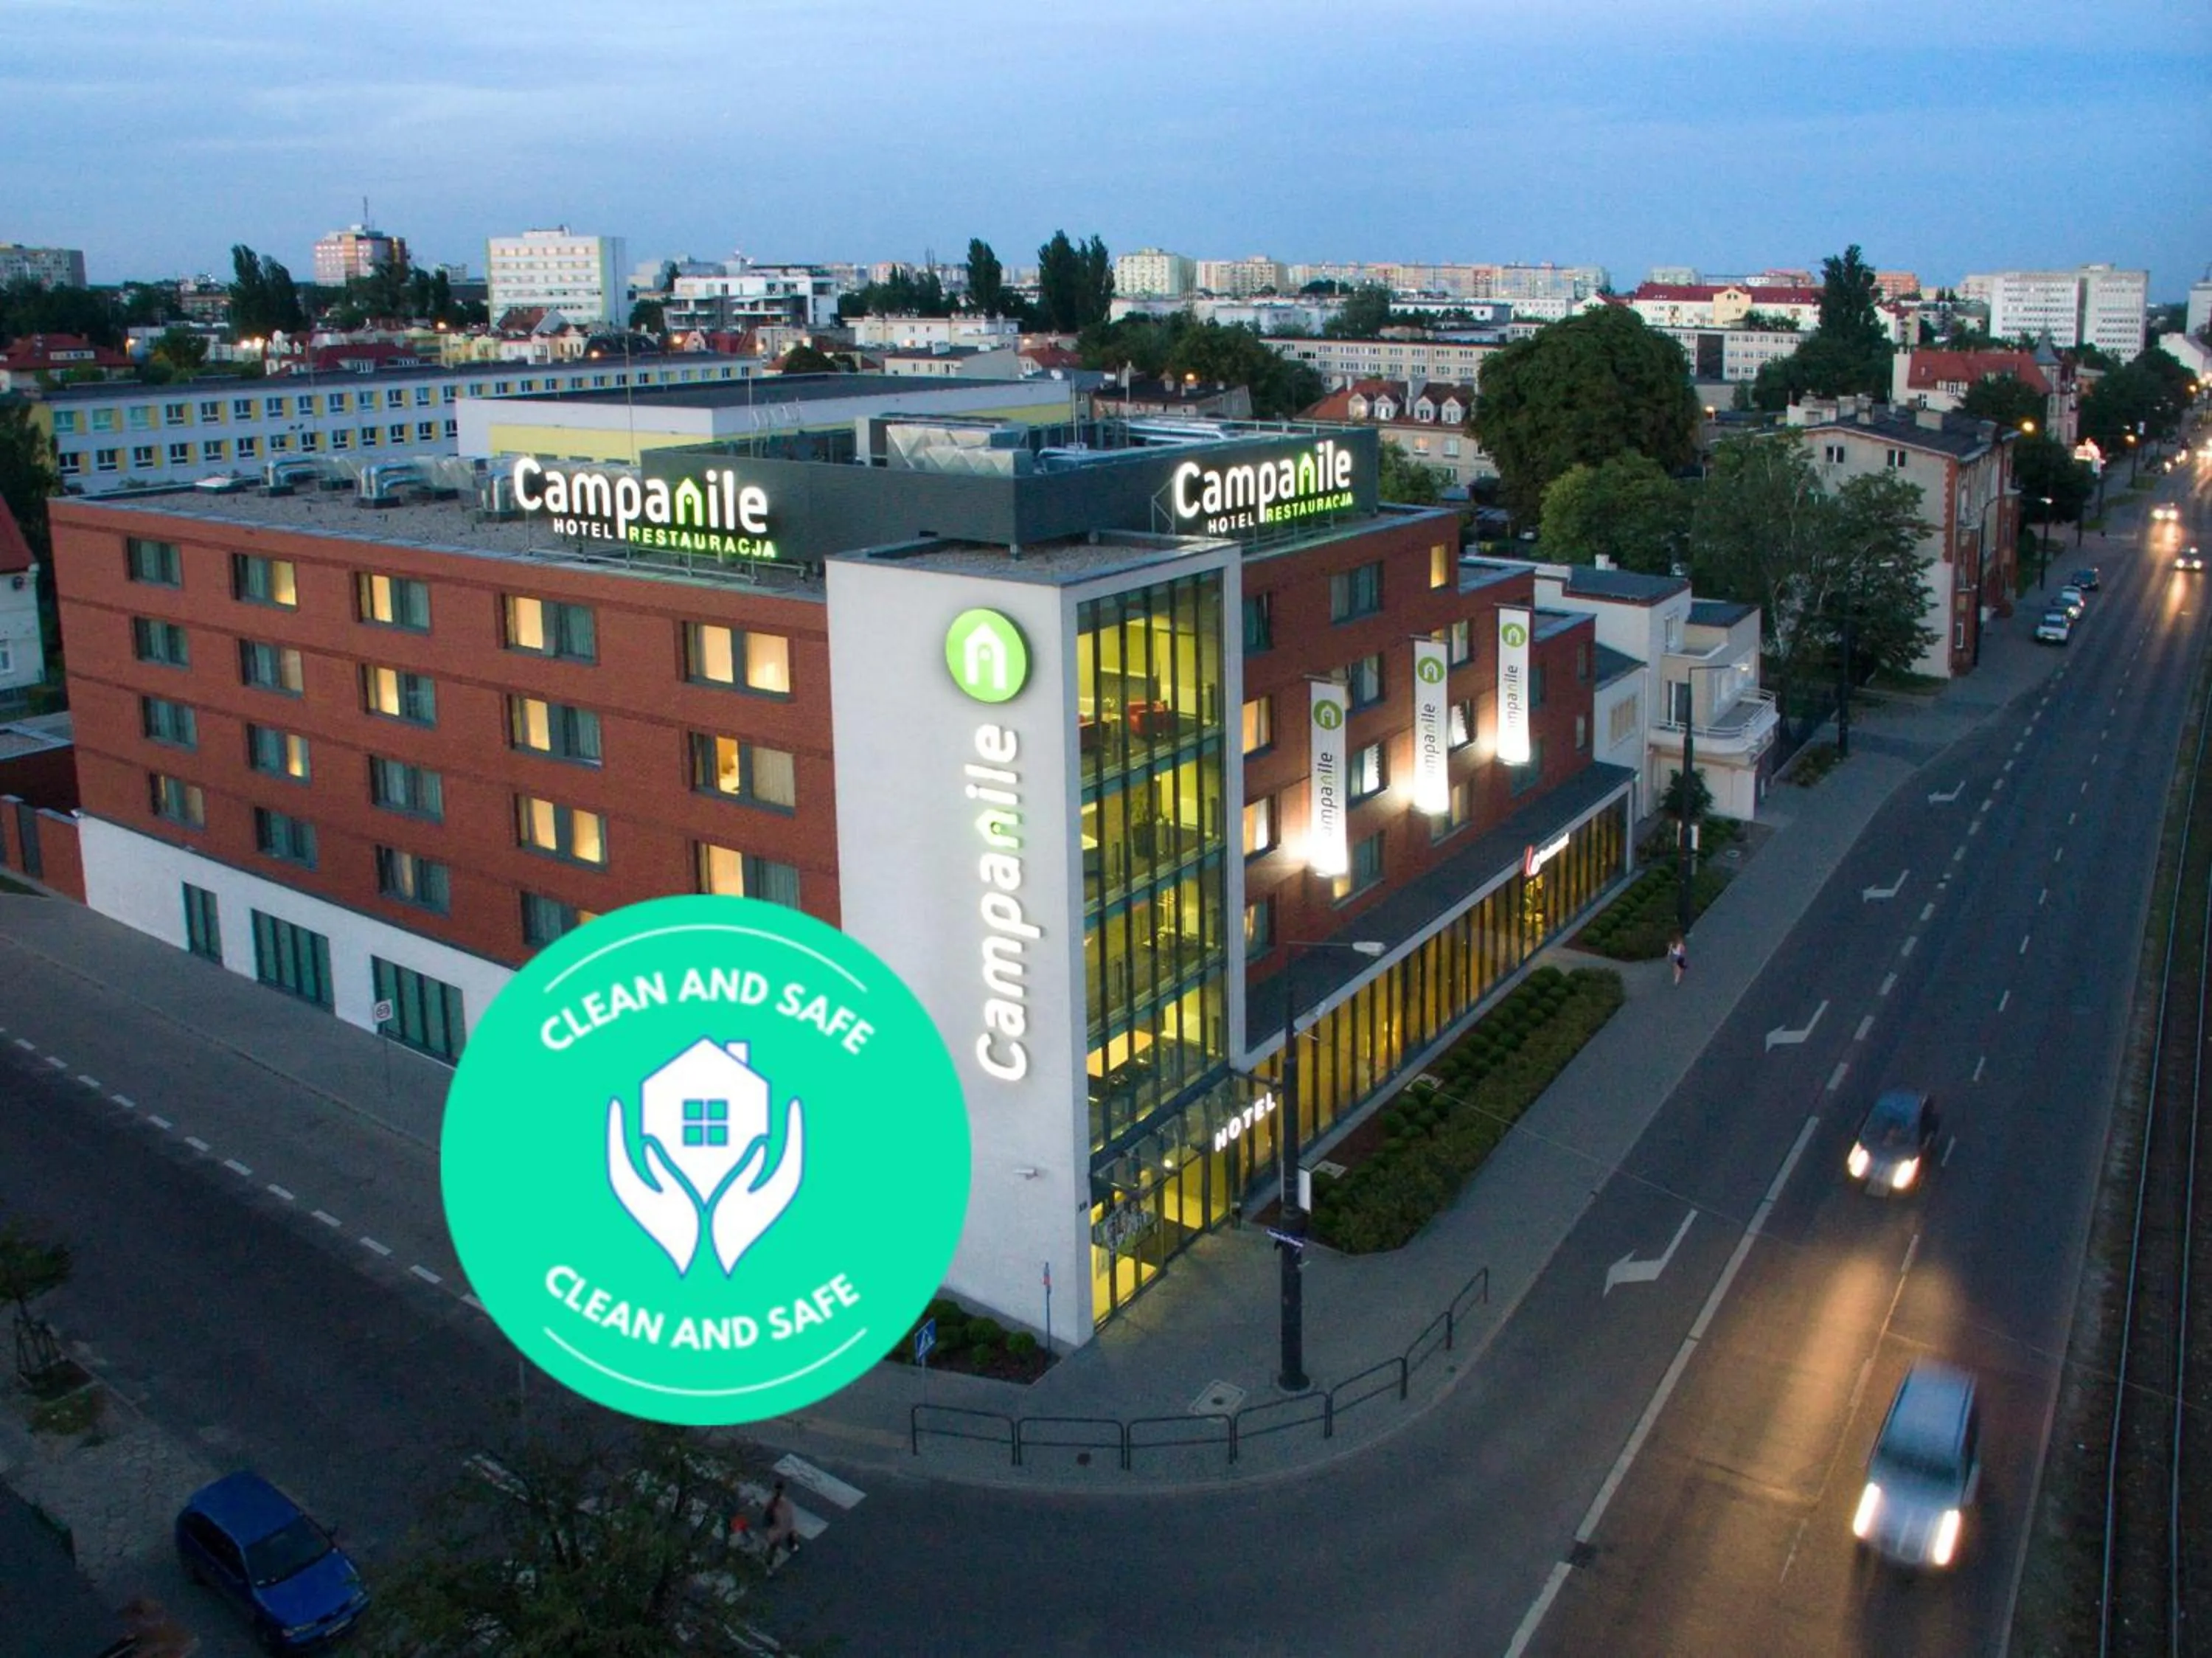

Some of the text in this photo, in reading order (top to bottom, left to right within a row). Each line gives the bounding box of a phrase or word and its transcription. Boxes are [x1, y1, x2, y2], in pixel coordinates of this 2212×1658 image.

[513, 457, 768, 539] Campanile
[1175, 440, 1352, 523] Campanile
[1208, 491, 1354, 534] HOTEL RESTAURACJA
[554, 518, 776, 558] HOTEL RESTAURACJA
[964, 723, 1043, 1082] Campanile
[1215, 1092, 1276, 1152] HOTEL
